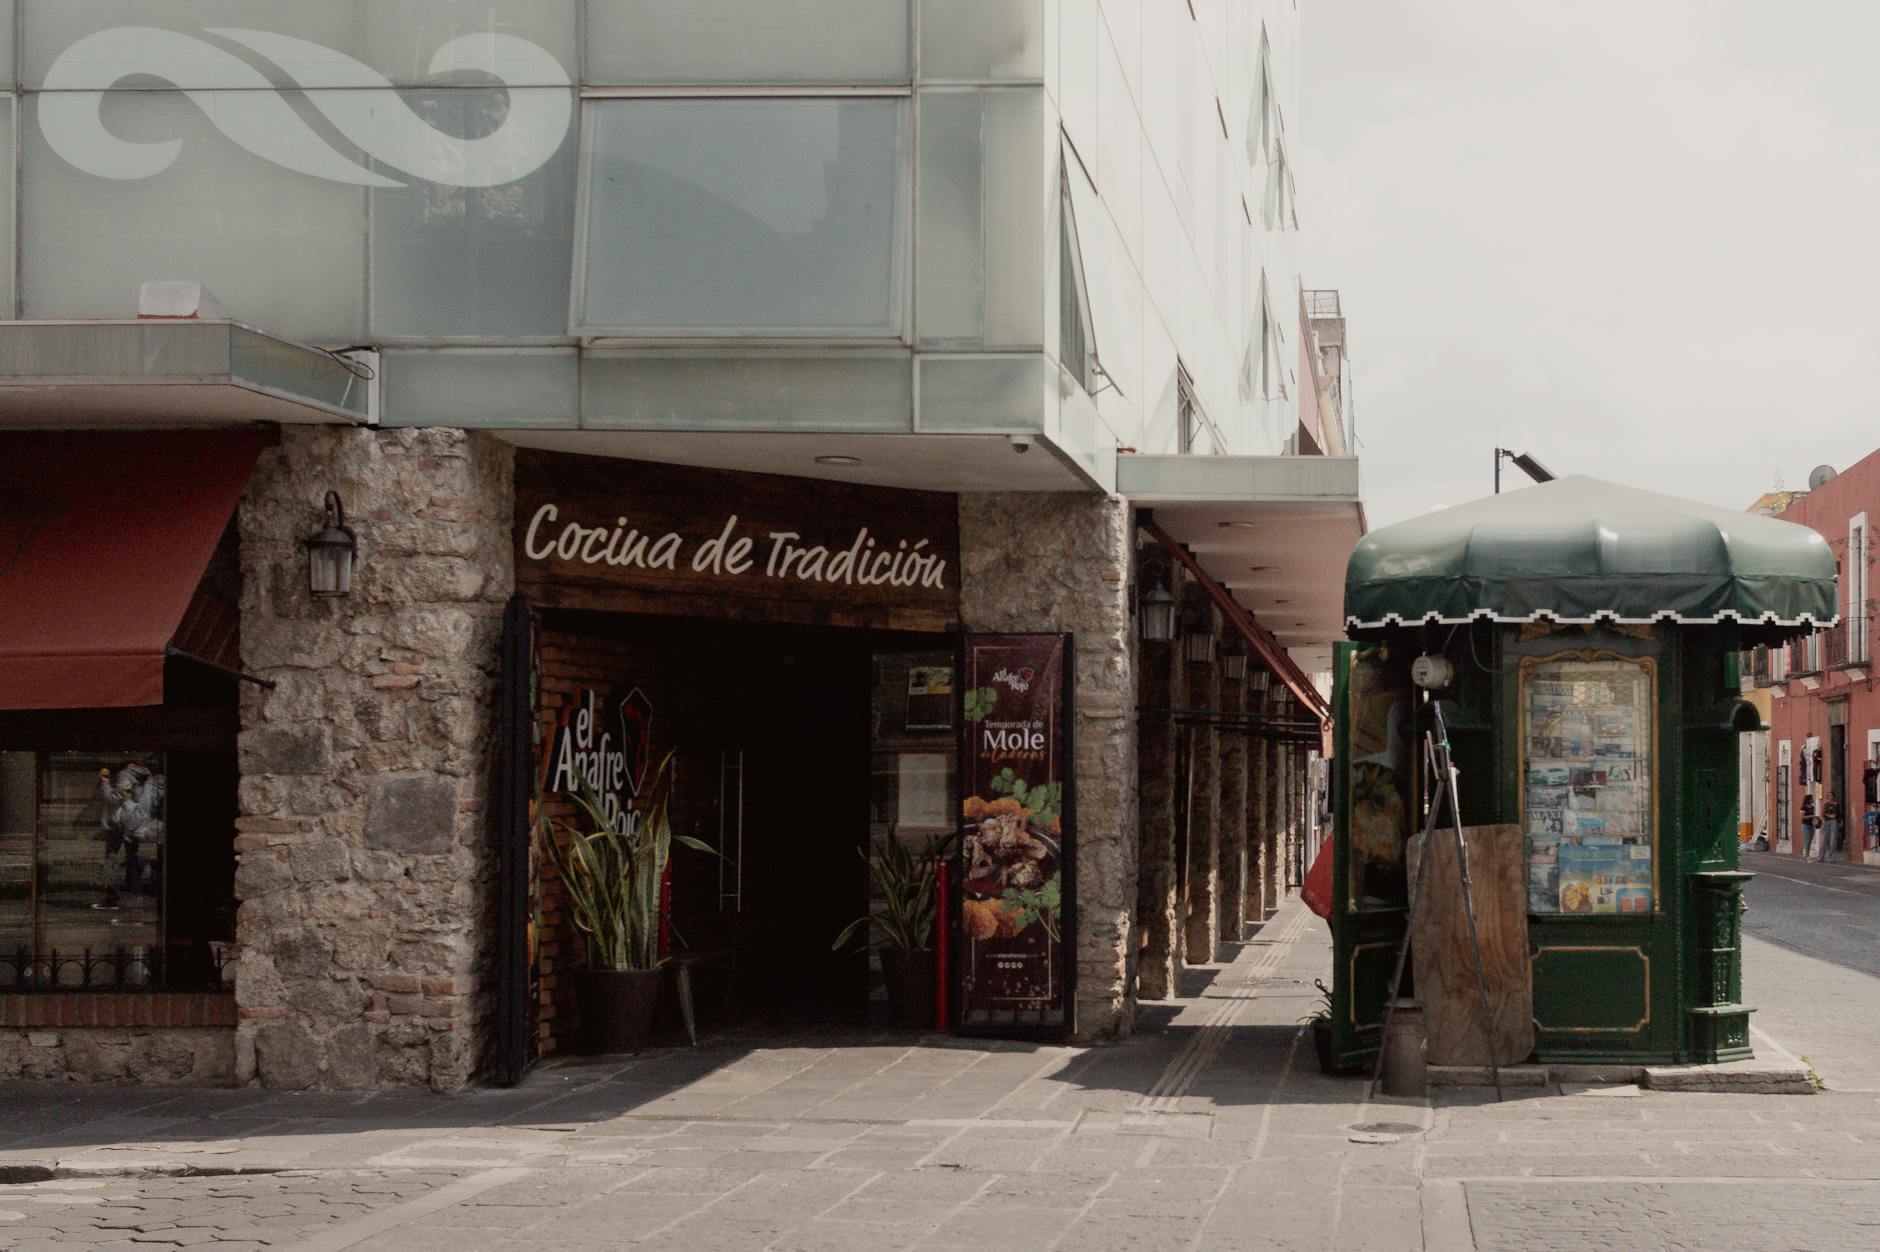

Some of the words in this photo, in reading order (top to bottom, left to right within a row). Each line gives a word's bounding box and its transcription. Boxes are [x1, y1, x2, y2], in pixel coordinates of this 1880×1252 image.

[524, 503, 683, 570] Cocina
[692, 514, 754, 575] de
[766, 527, 946, 589] Tradición
[576, 689, 594, 749] el
[983, 728, 1045, 751] Mole
[985, 720, 1031, 730] Temporada
[1032, 720, 1044, 729] de
[552, 725, 624, 804] Anafre
